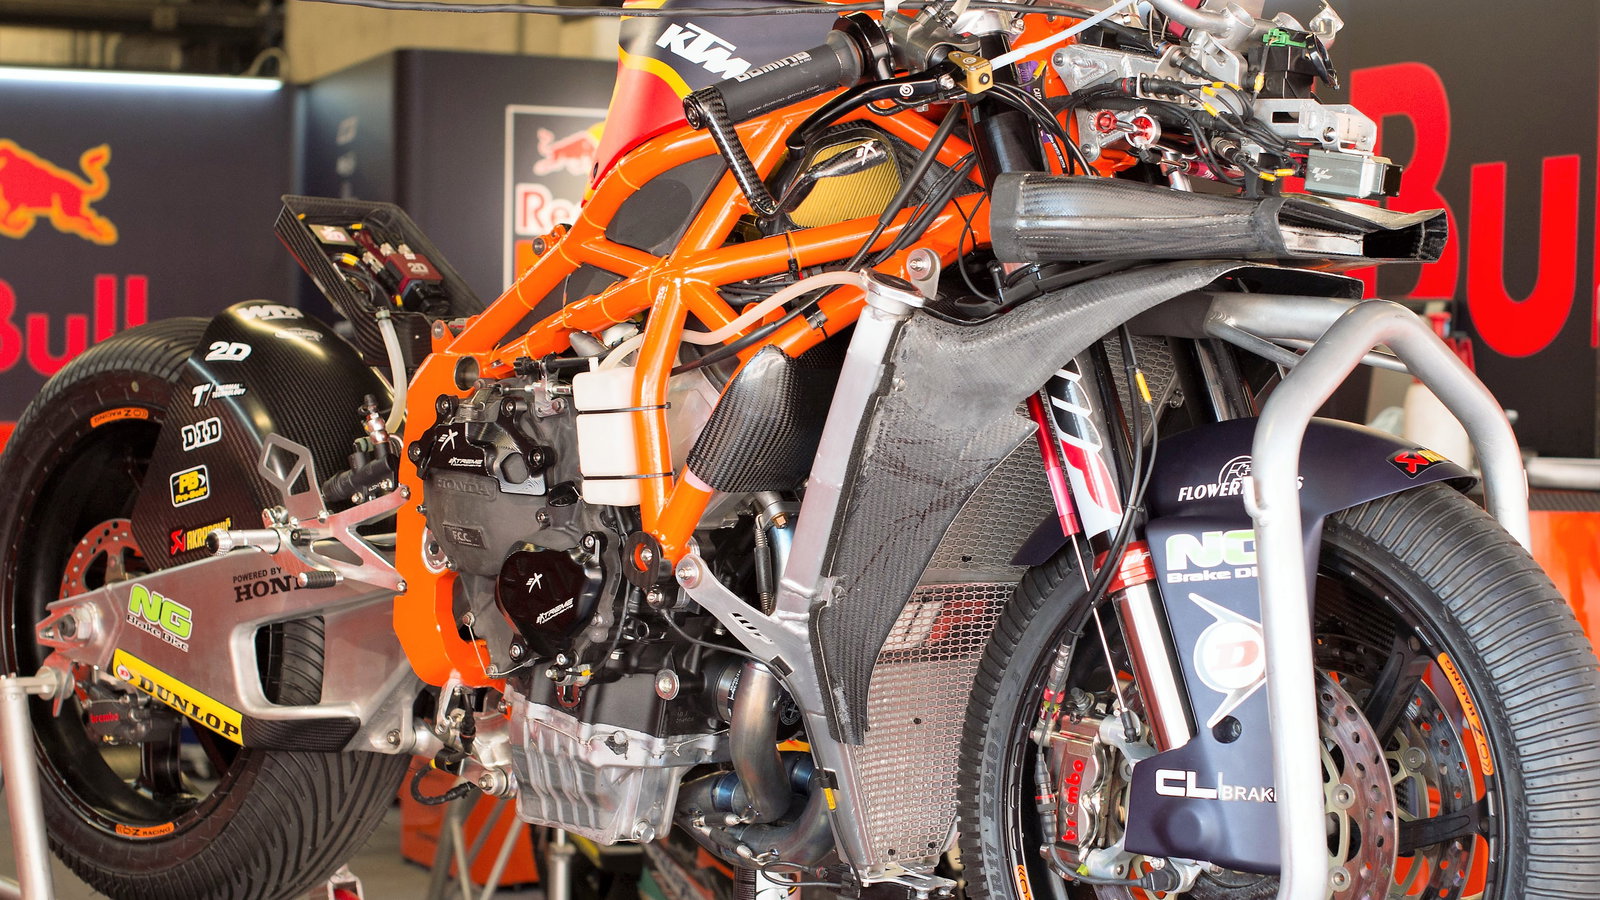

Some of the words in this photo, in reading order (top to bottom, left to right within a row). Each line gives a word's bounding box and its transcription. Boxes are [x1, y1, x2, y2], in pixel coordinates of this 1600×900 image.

[655, 22, 752, 80] KTM
[515, 183, 583, 236] Re
[1345, 62, 1600, 358] Bu
[205, 341, 252, 362] 2D
[233, 569, 268, 583] POWERED
[270, 566, 282, 576] BY
[1166, 570, 1232, 584] Brake
[127, 614, 161, 638] Brake
[161, 631, 189, 652] Disc
[128, 584, 192, 640] NG
[138, 675, 239, 737] DUNLOP
[1444, 659, 1476, 717] RACING
[1062, 759, 1085, 841] brembo
[1156, 769, 1218, 799] CL
